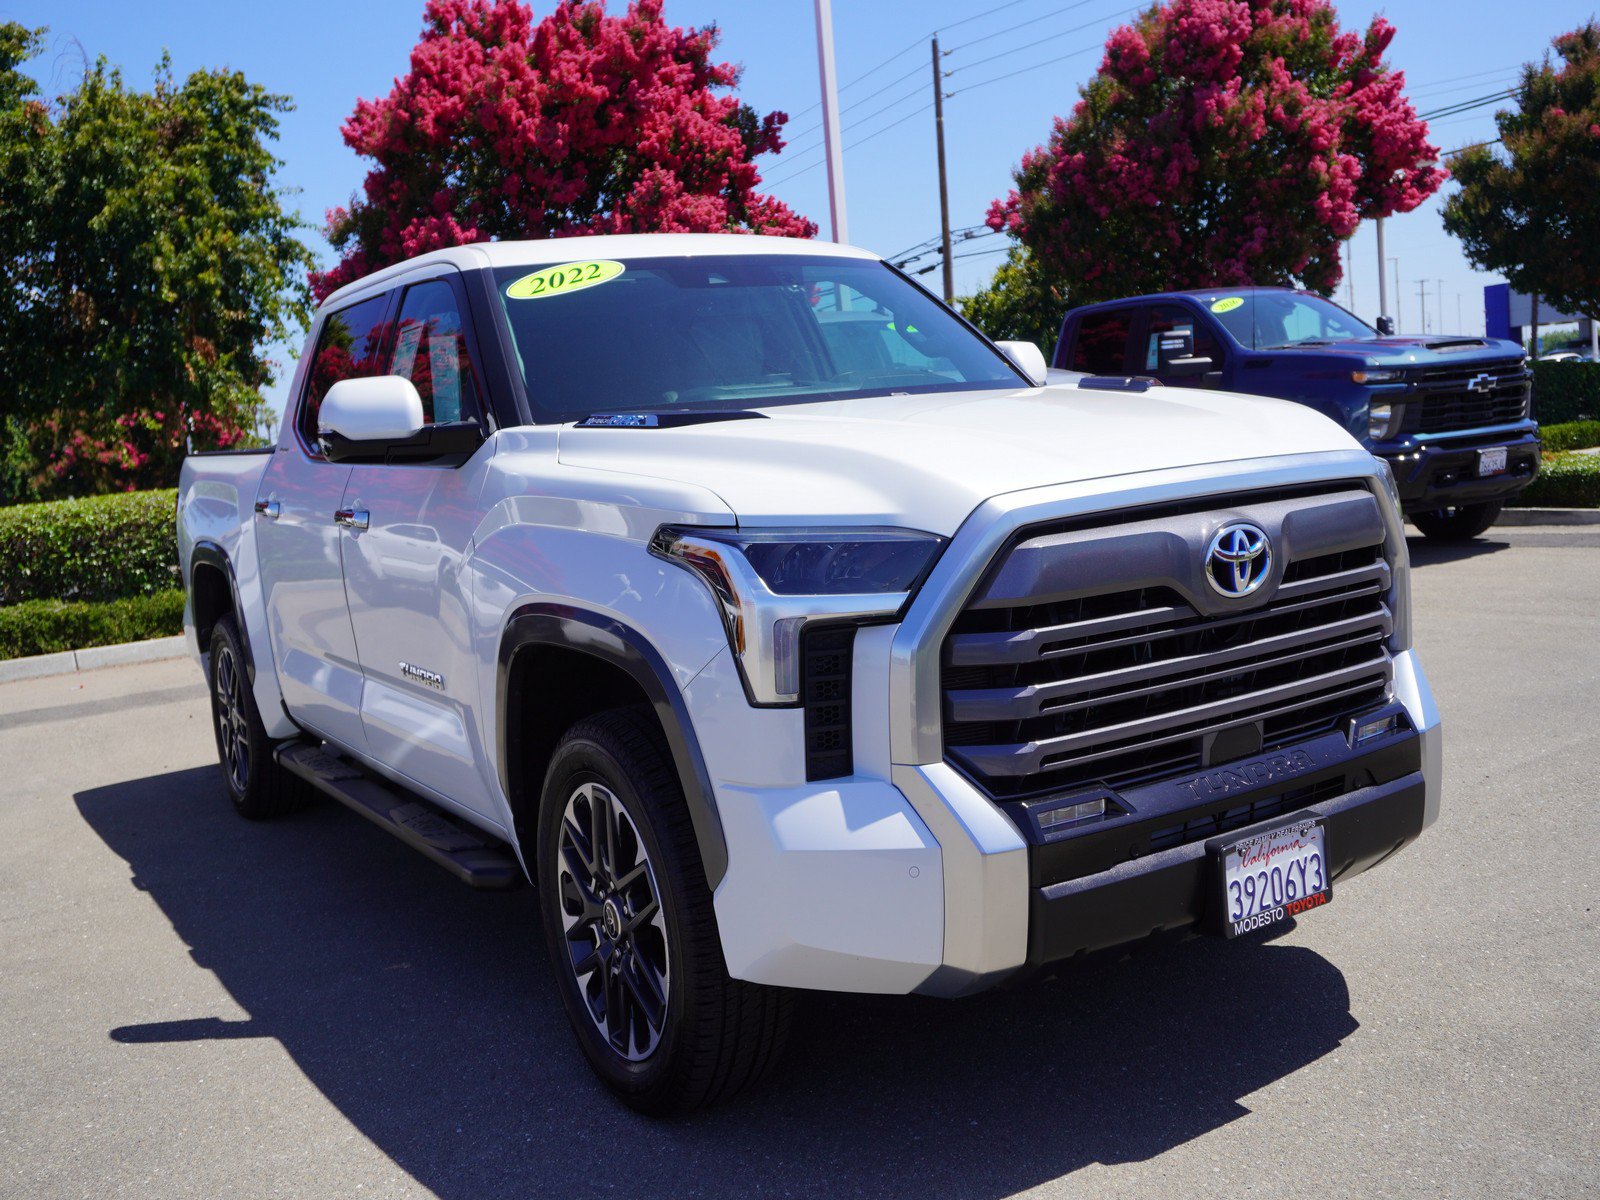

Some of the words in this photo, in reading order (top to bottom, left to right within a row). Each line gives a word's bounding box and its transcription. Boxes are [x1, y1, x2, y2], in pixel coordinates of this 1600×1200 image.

[530, 264, 601, 295] 2022
[399, 661, 445, 691] TUNDRA
[1176, 749, 1316, 801] TUNDRA
[1254, 832, 1277, 846] FAMILY
[1277, 820, 1316, 838] DEALERSHIPS
[1242, 838, 1309, 868] California
[1229, 853, 1323, 921] 39206Y3
[1234, 908, 1284, 936] MODESTO
[1286, 892, 1327, 917] TOYOTA
